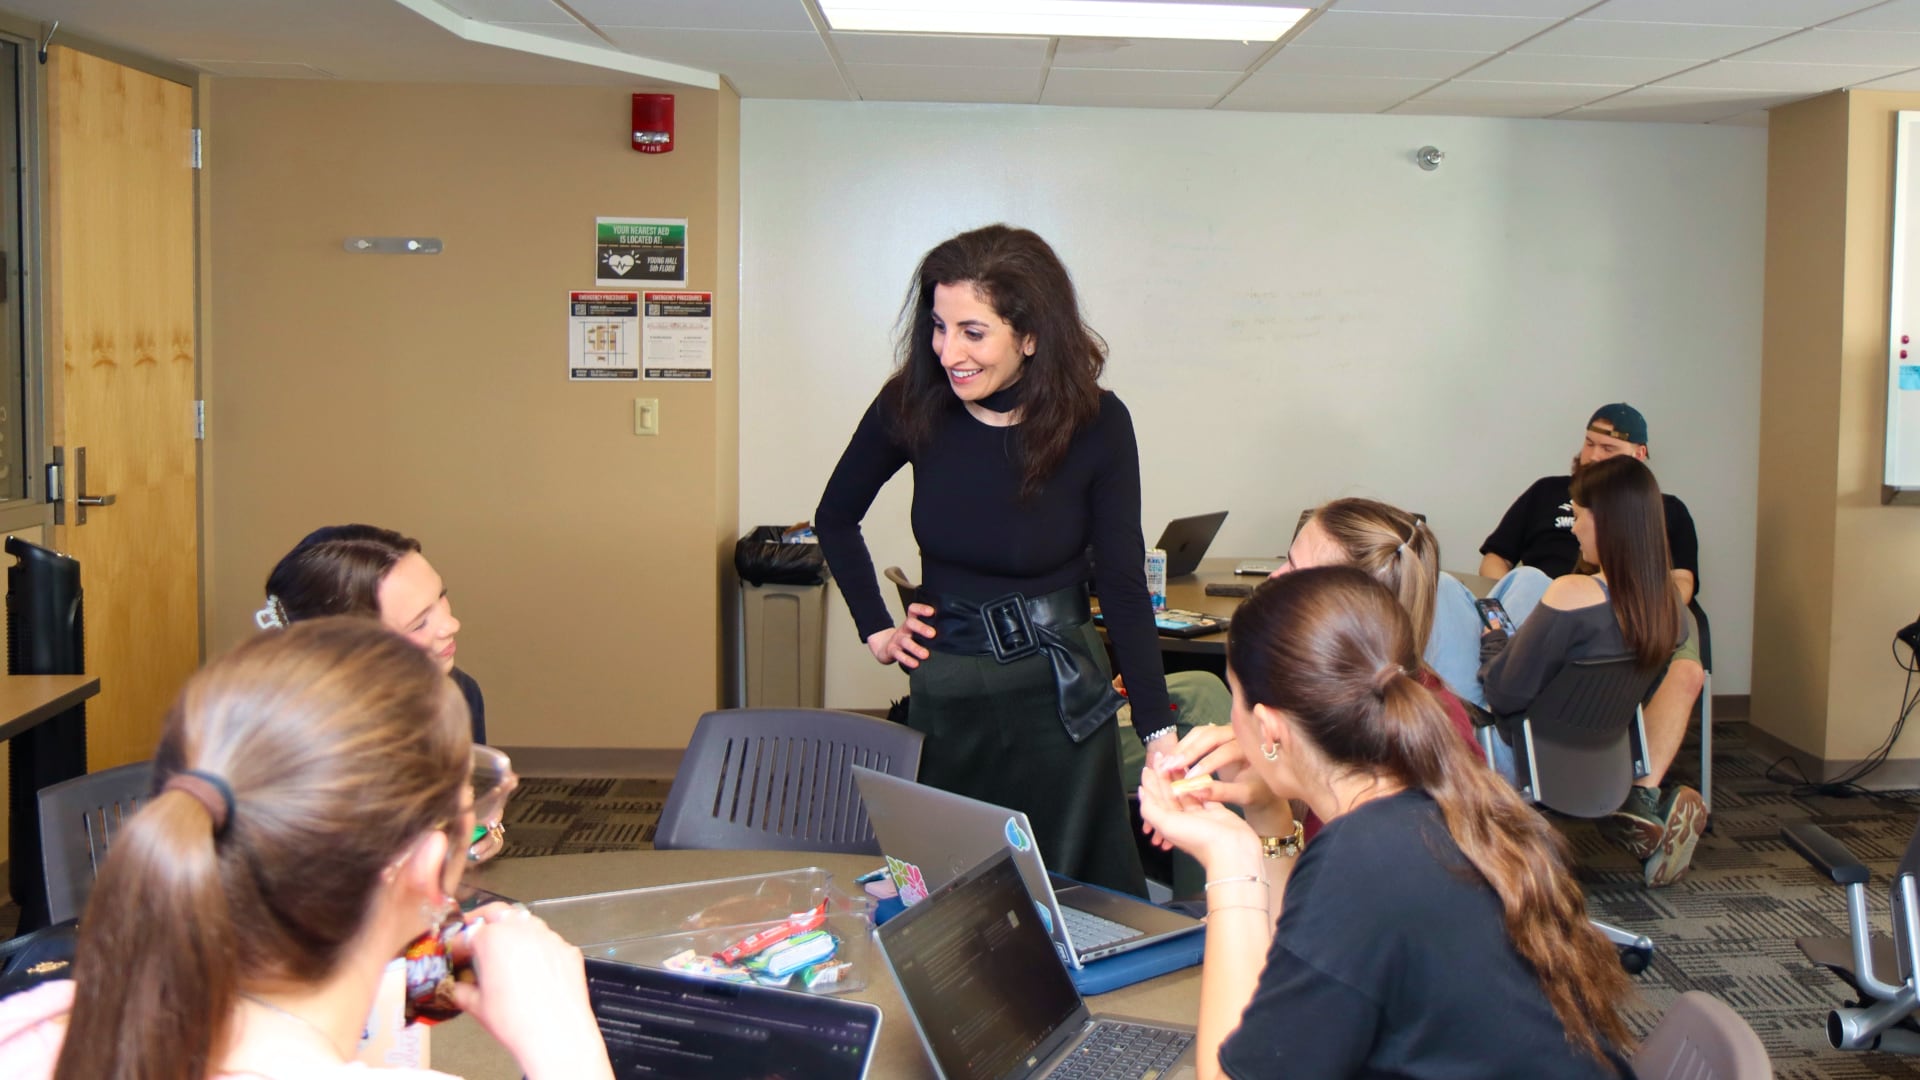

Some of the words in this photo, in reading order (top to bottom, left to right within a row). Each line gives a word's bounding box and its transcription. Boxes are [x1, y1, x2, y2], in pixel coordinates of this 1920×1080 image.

[613, 225, 629, 235] YOUR
[630, 225, 656, 235] NEAREST
[657, 226, 670, 236] AED
[620, 236, 626, 244] IS
[627, 236, 652, 244] LOCATED
[653, 236, 662, 245] AT:
[647, 256, 664, 264] YOUNG
[665, 256, 678, 265] HALL
